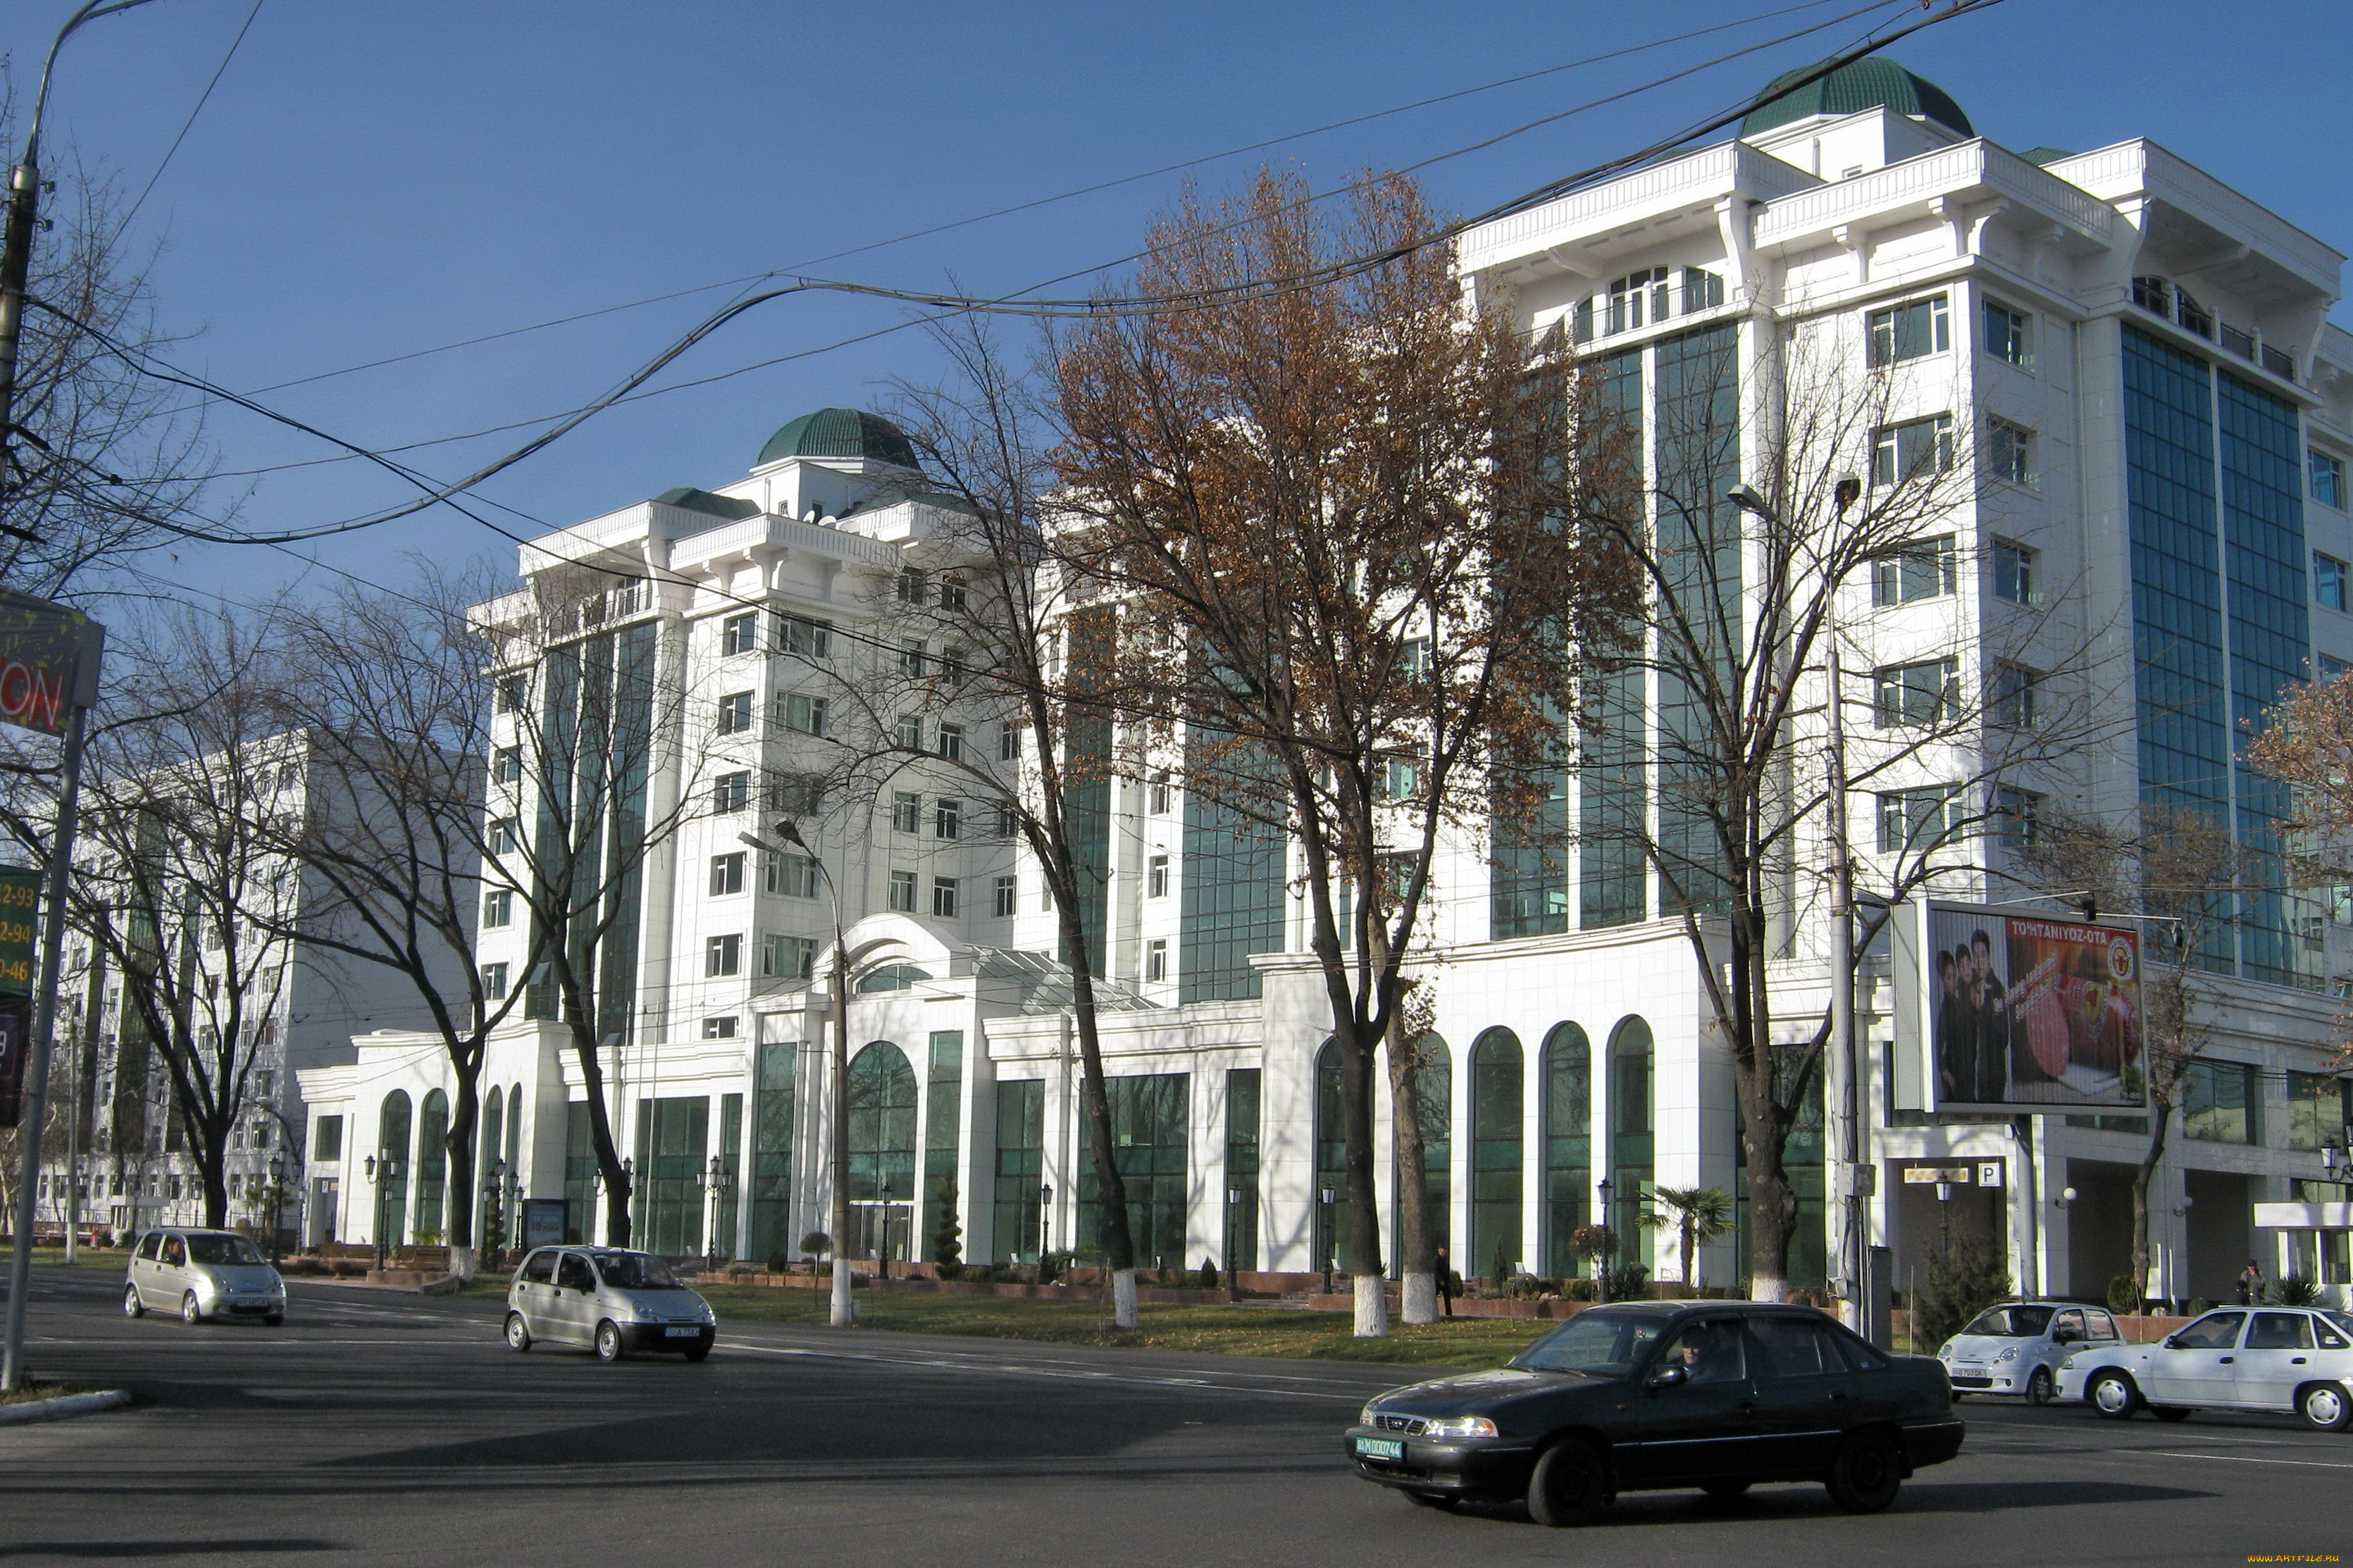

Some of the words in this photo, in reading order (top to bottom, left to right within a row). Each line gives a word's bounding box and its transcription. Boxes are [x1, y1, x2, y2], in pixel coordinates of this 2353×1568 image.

[0, 657, 63, 729] ON
[0, 884, 34, 908] 2-93
[1984, 1167, 1994, 1183] P
